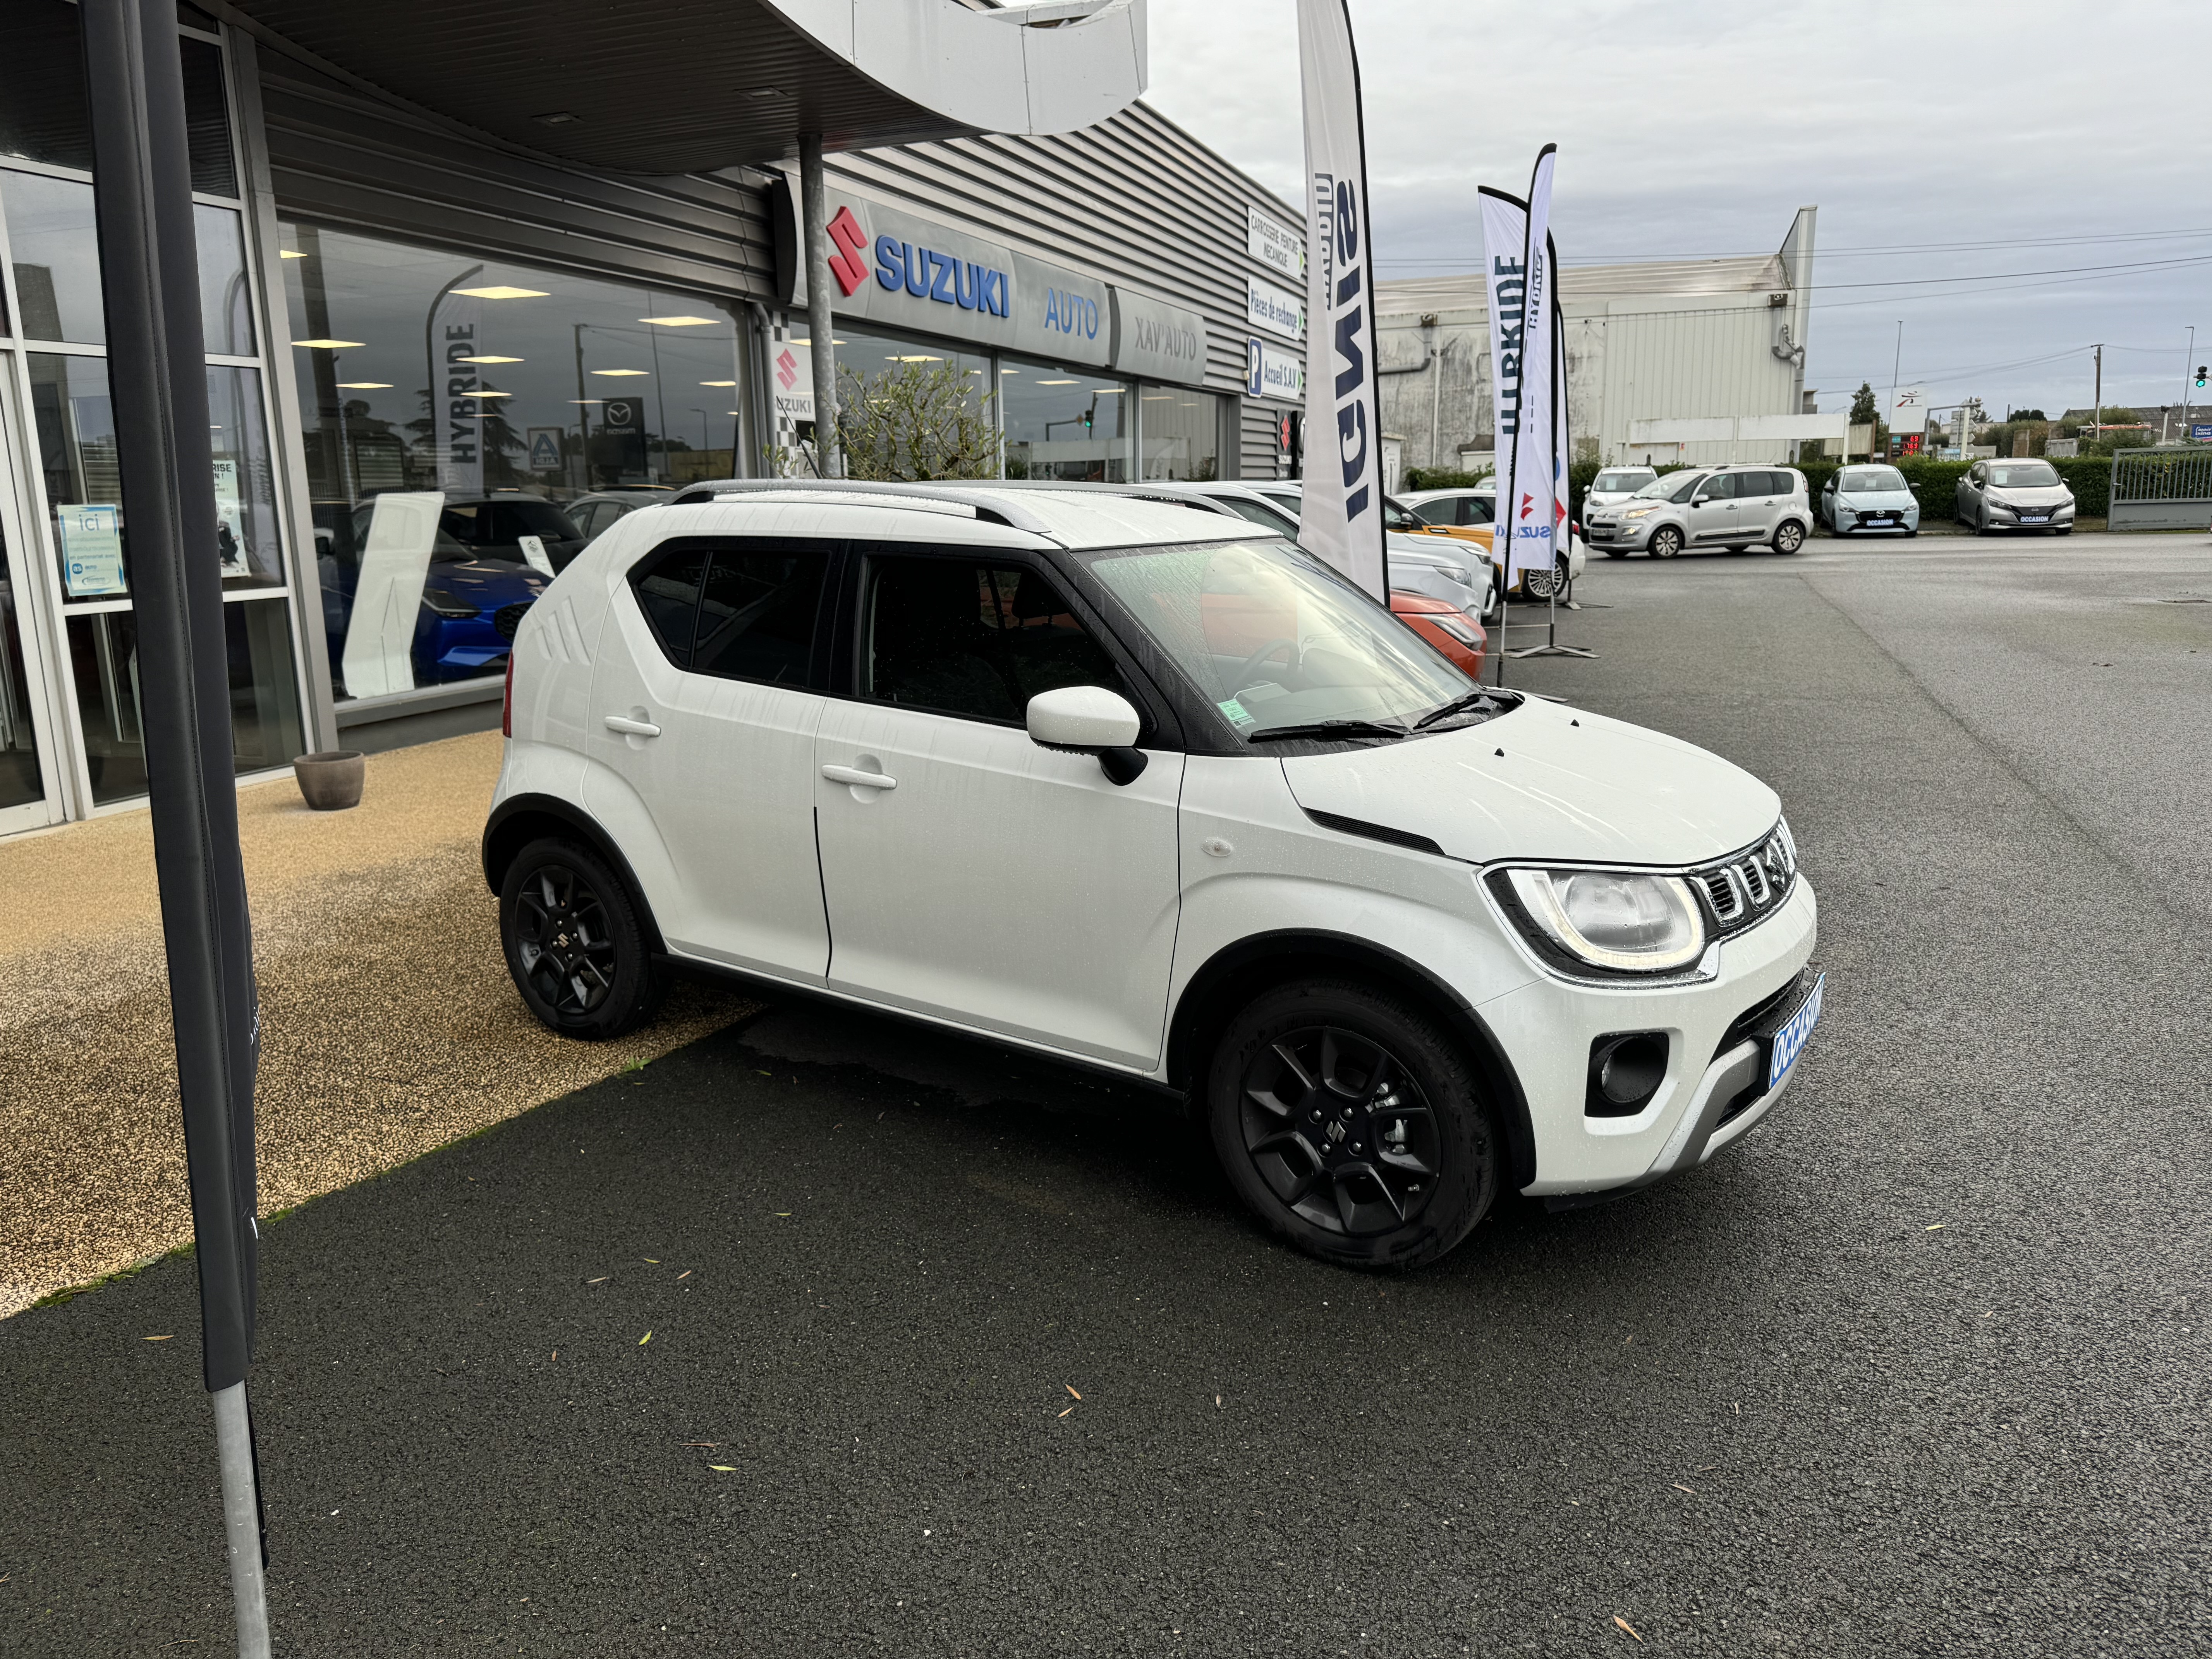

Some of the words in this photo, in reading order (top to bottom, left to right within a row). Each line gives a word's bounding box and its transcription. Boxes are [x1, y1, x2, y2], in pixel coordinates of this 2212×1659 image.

[876, 235, 1010, 318] SUZUKI
[1044, 287, 1098, 340] AUTO
[1269, 296, 1275, 321] de
[1135, 316, 1197, 361] XAV'AUTO
[1252, 345, 1259, 388] P
[1264, 361, 1283, 386] Accueil
[446, 324, 477, 464] HYBRIDE
[79, 514, 100, 531] ici
[1774, 980, 1824, 1078] OCCASION
